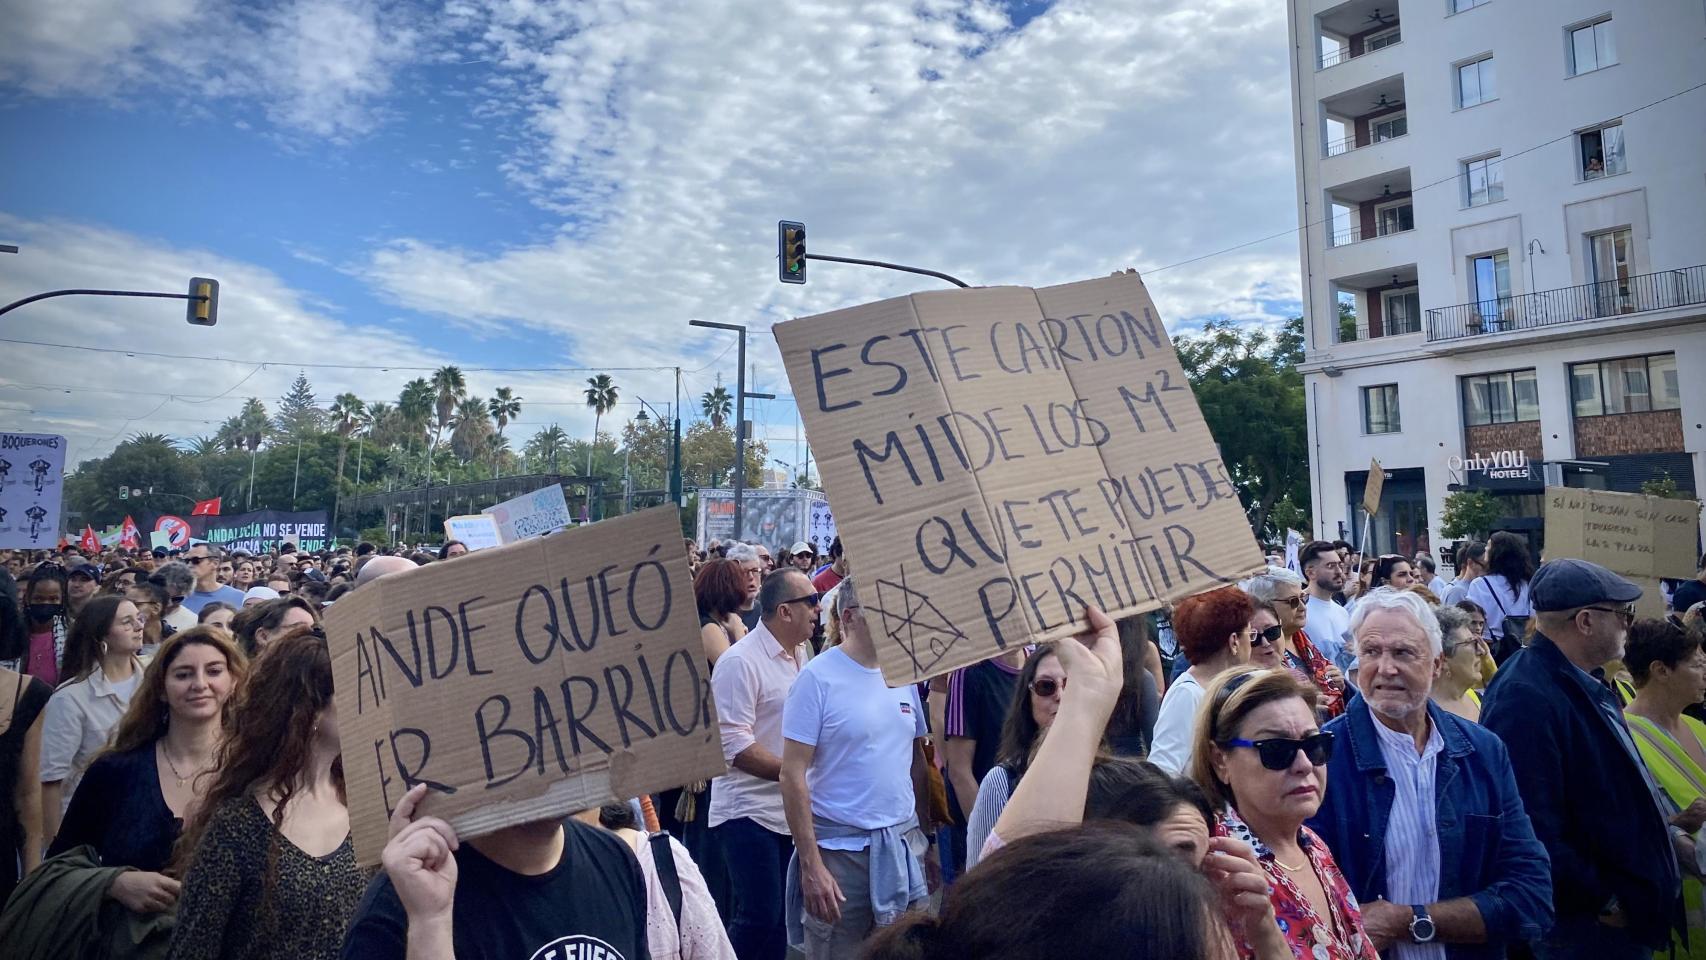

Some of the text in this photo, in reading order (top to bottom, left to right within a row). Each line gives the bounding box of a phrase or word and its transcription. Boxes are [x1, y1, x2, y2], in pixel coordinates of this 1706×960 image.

[811, 301, 1161, 412] ESTE CARTÓN
[2, 435, 58, 450] BOQUERONES
[1024, 398, 1110, 455] LOS
[1490, 470, 1528, 479] HOTELS
[207, 522, 325, 543] ANDALUCÍA NO SE VENDE
[916, 459, 1235, 574] QUE TE PUEDES
[356, 544, 671, 714] ANDE QUEÓ
[375, 728, 457, 820] ER
